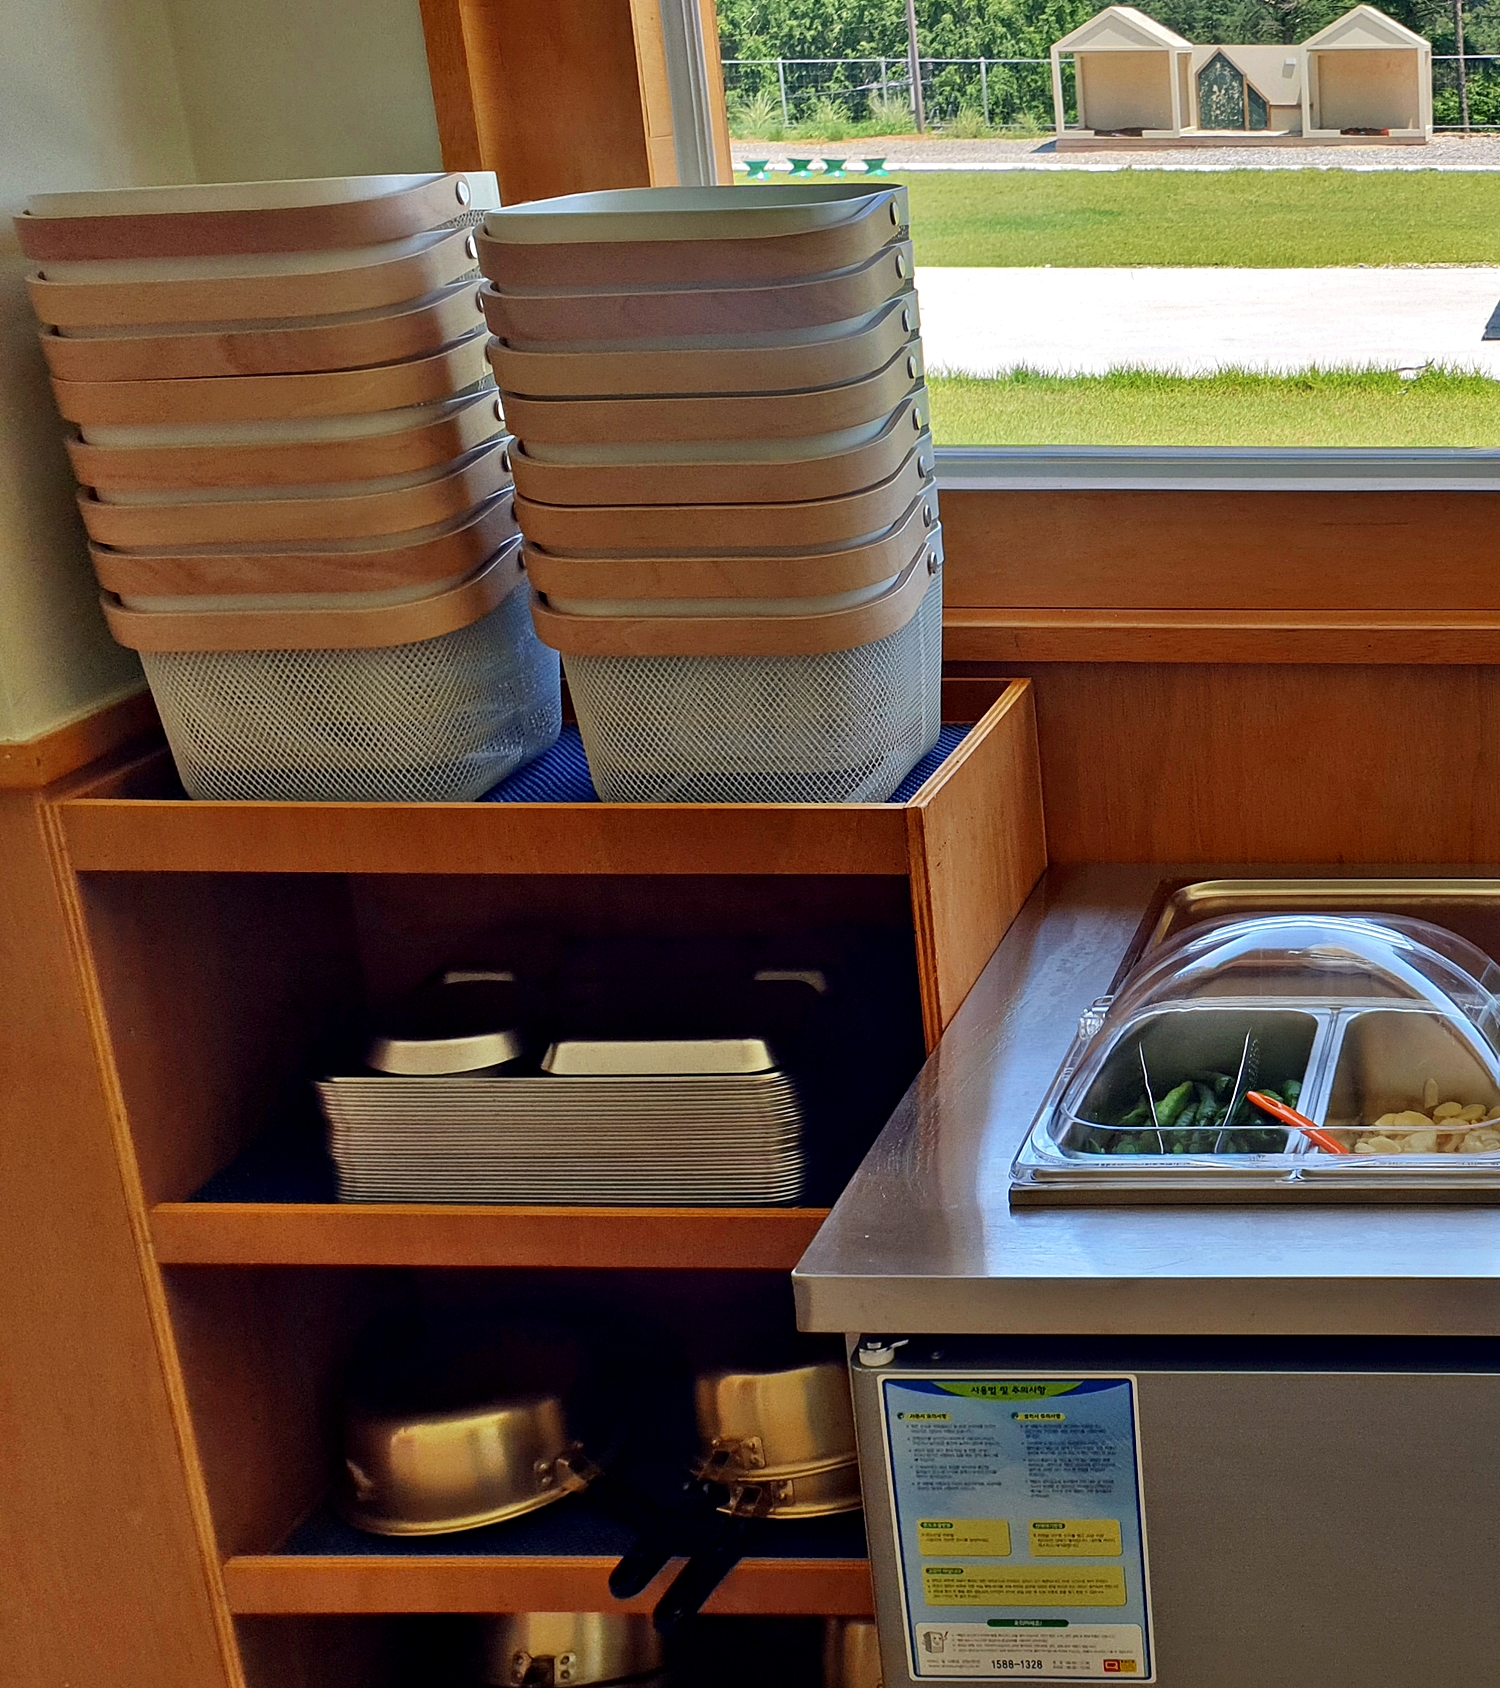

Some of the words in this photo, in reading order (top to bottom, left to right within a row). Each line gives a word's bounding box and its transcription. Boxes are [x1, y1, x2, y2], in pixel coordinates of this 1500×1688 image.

[971, 1385, 997, 1396] 사용법
[999, 1385, 1008, 1396] 및
[1011, 1385, 1046, 1396] 주의사항
[991, 1659, 1043, 1670] 1588-1328
